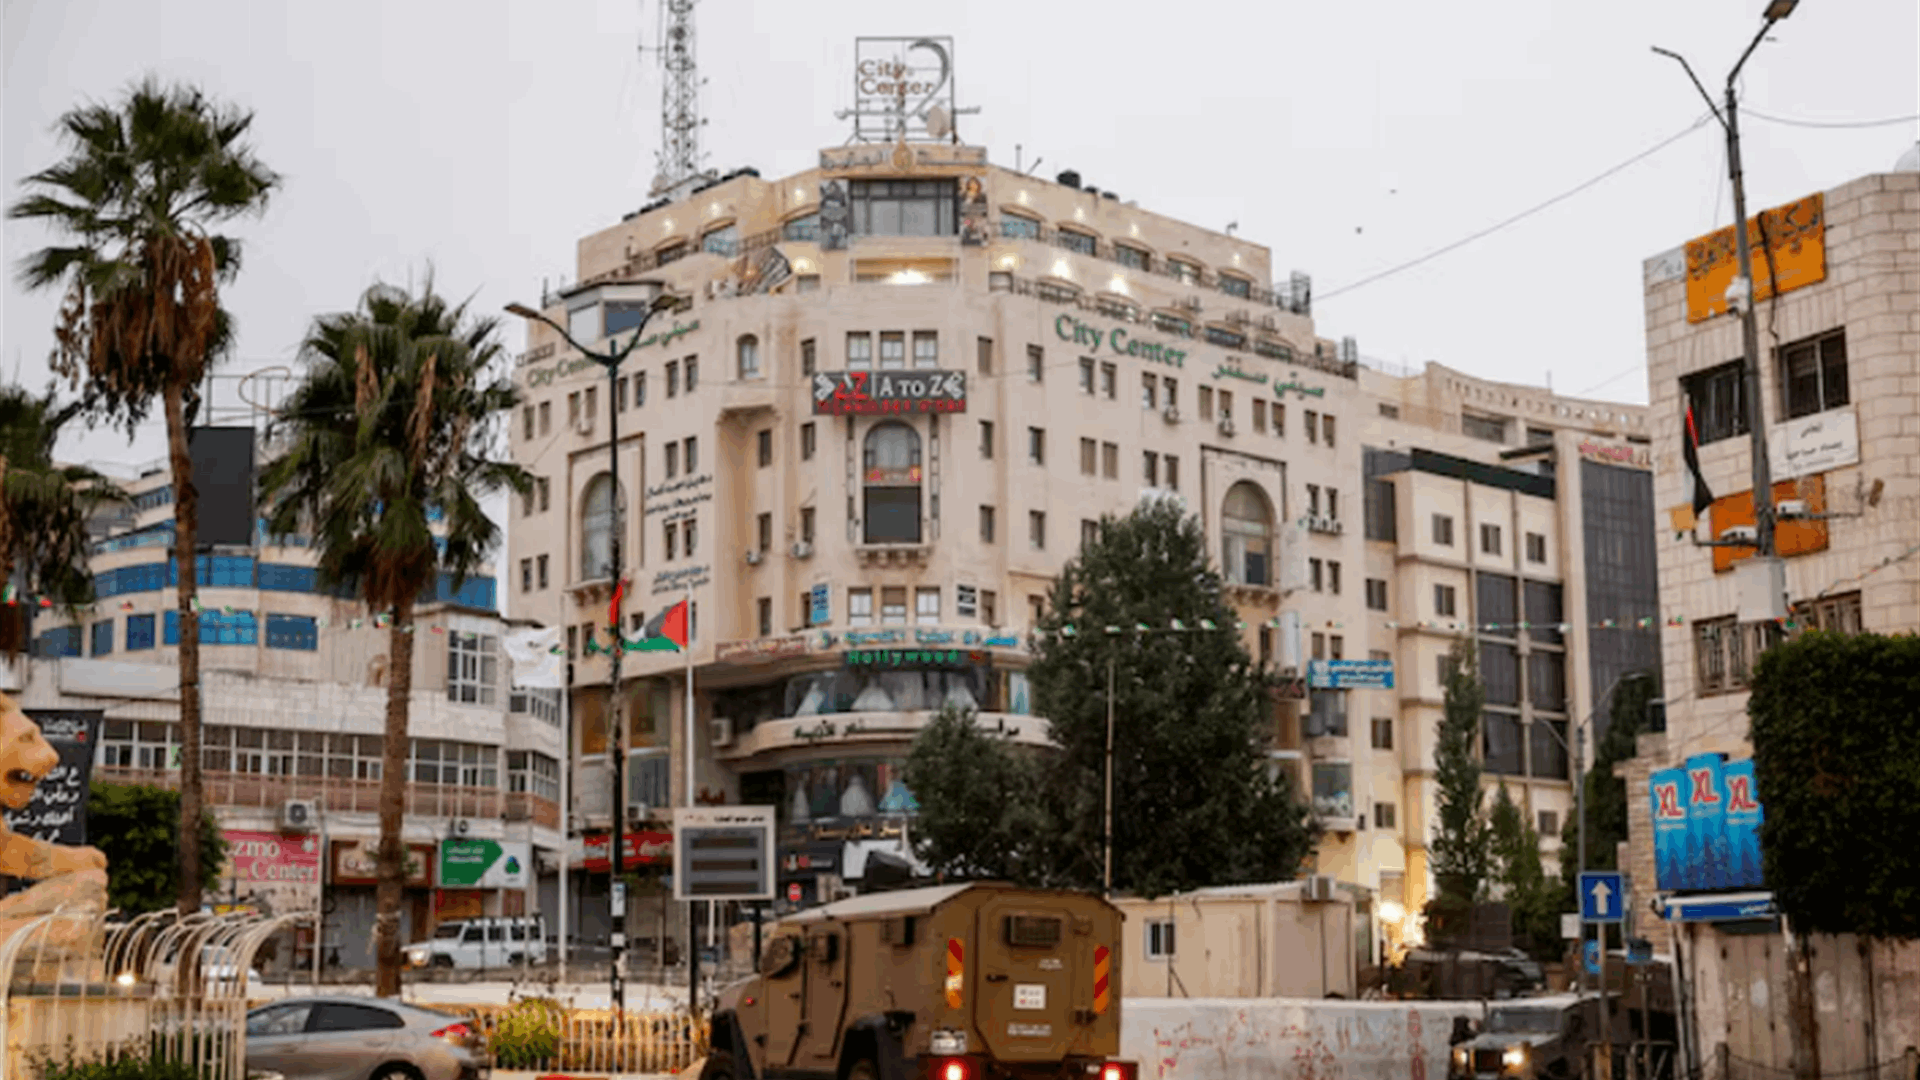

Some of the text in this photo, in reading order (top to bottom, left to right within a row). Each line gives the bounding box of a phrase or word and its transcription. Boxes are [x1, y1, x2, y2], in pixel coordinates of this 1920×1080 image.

[859, 59, 906, 80] City
[859, 78, 935, 96] Center
[1055, 313, 1188, 368] City Center
[880, 376, 894, 397] A
[929, 375, 944, 397] Z
[848, 649, 959, 666] Hollywood
[1692, 769, 1720, 804] XL
[1728, 775, 1759, 813] XL
[1654, 783, 1684, 818] XL
[251, 861, 315, 879] Center
